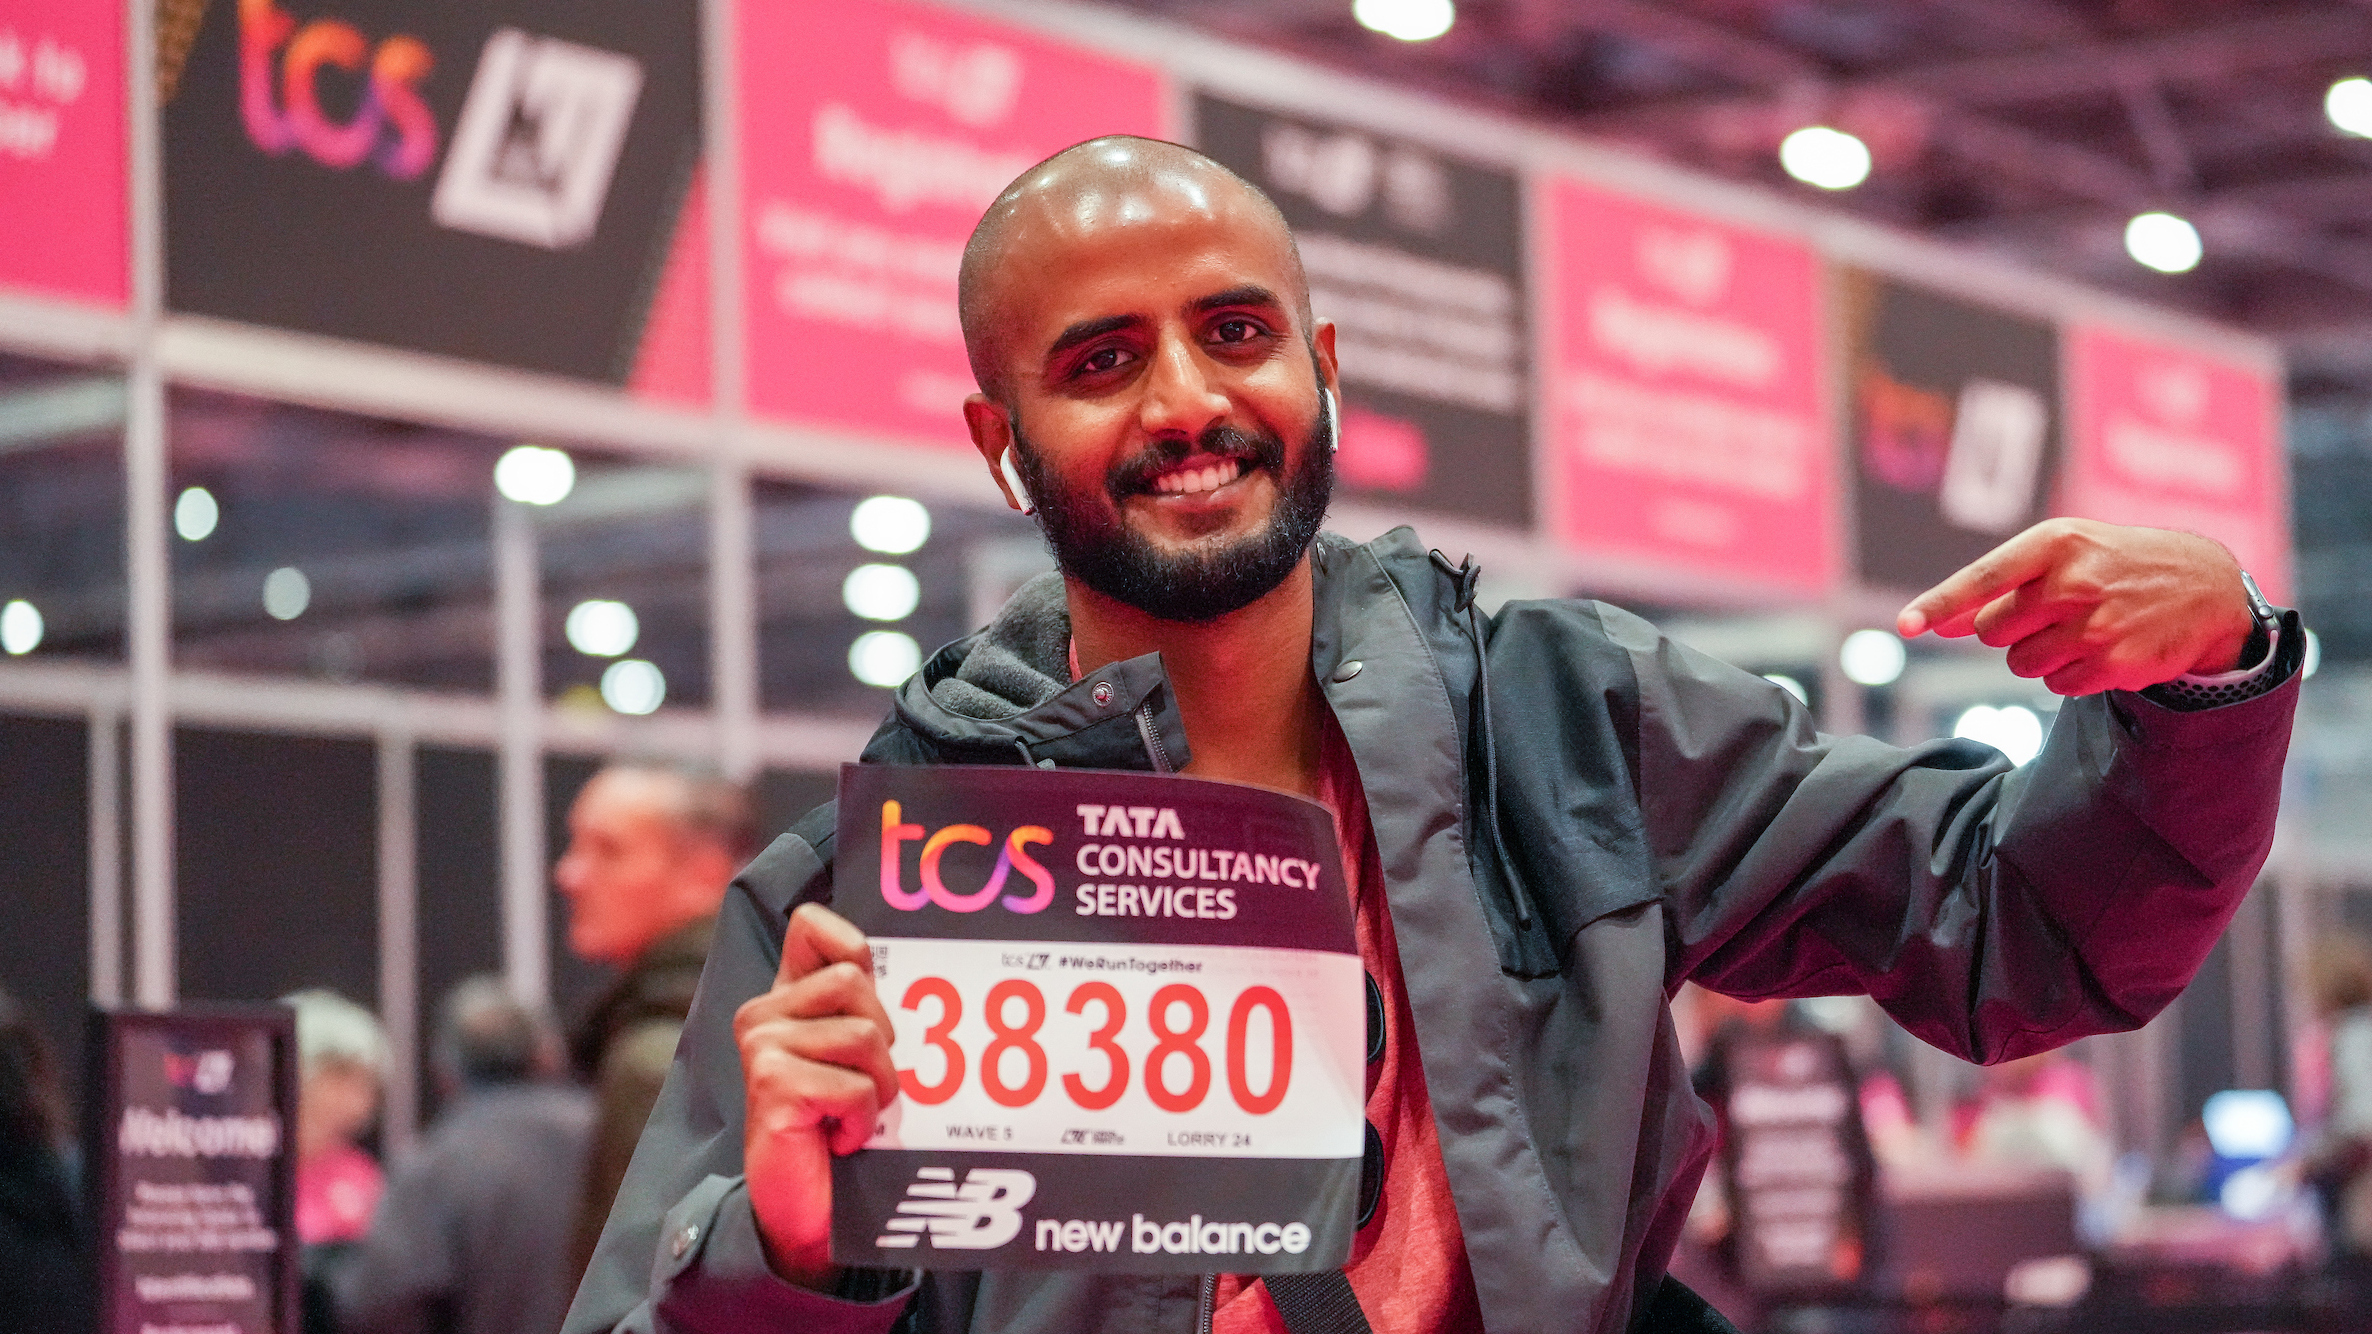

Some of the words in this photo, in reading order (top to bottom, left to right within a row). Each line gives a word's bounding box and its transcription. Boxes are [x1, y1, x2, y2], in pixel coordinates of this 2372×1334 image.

[1076, 804, 1186, 840] TATA
[880, 799, 1056, 914] tcs
[1076, 843, 1321, 891] CONSULTANCY
[1075, 883, 1238, 920] SERVICES
[900, 977, 1293, 1114] 38380
[946, 1125, 998, 1140] WAVE
[1167, 1131, 1227, 1147] LORRY
[1034, 1219, 1126, 1253] new
[1131, 1213, 1312, 1254] balance
